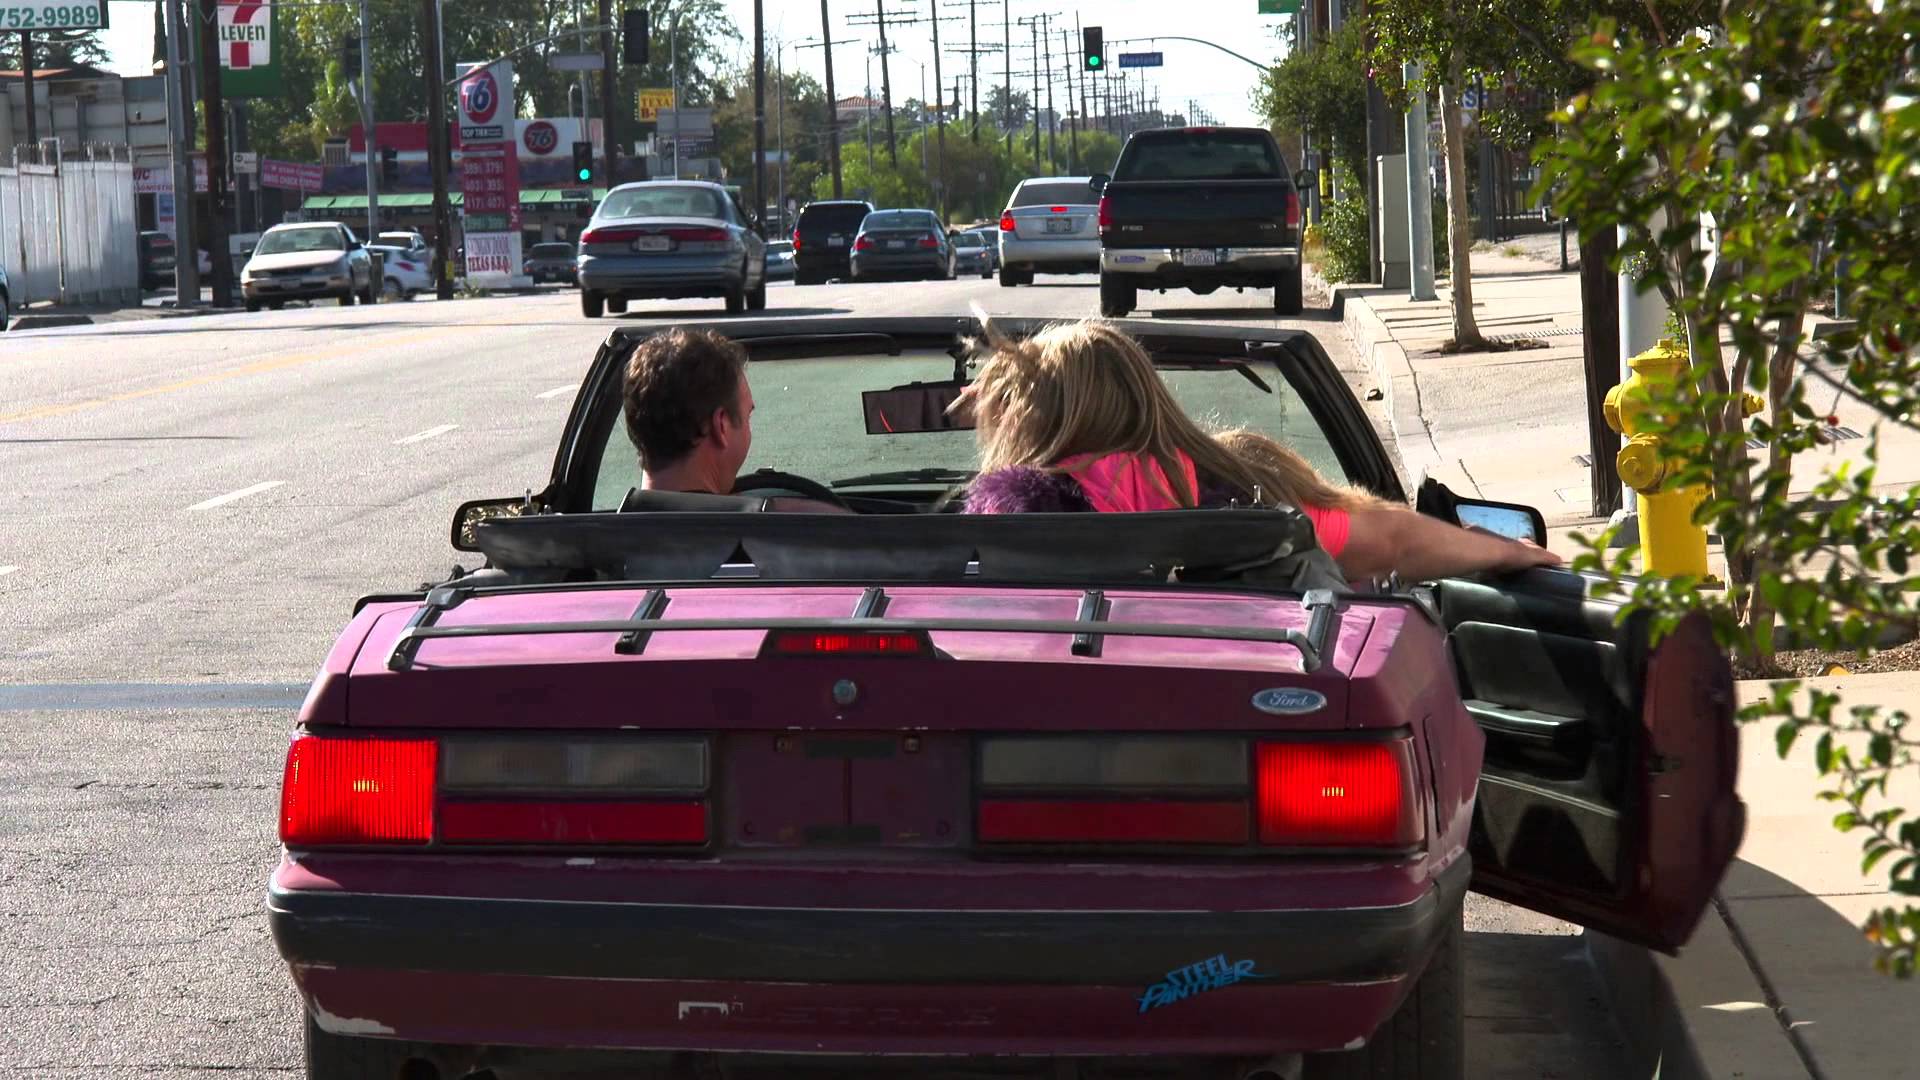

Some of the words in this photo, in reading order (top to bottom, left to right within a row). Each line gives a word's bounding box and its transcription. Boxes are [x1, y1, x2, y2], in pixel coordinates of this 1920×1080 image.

[461, 79, 491, 113] 76
[641, 97, 673, 108] TEXA
[527, 128, 554, 149] 76
[468, 256, 490, 272] TEXAS
[1269, 692, 1308, 706] Ford
[1165, 953, 1232, 988] STEEL
[1136, 959, 1278, 1013] PANTHER
